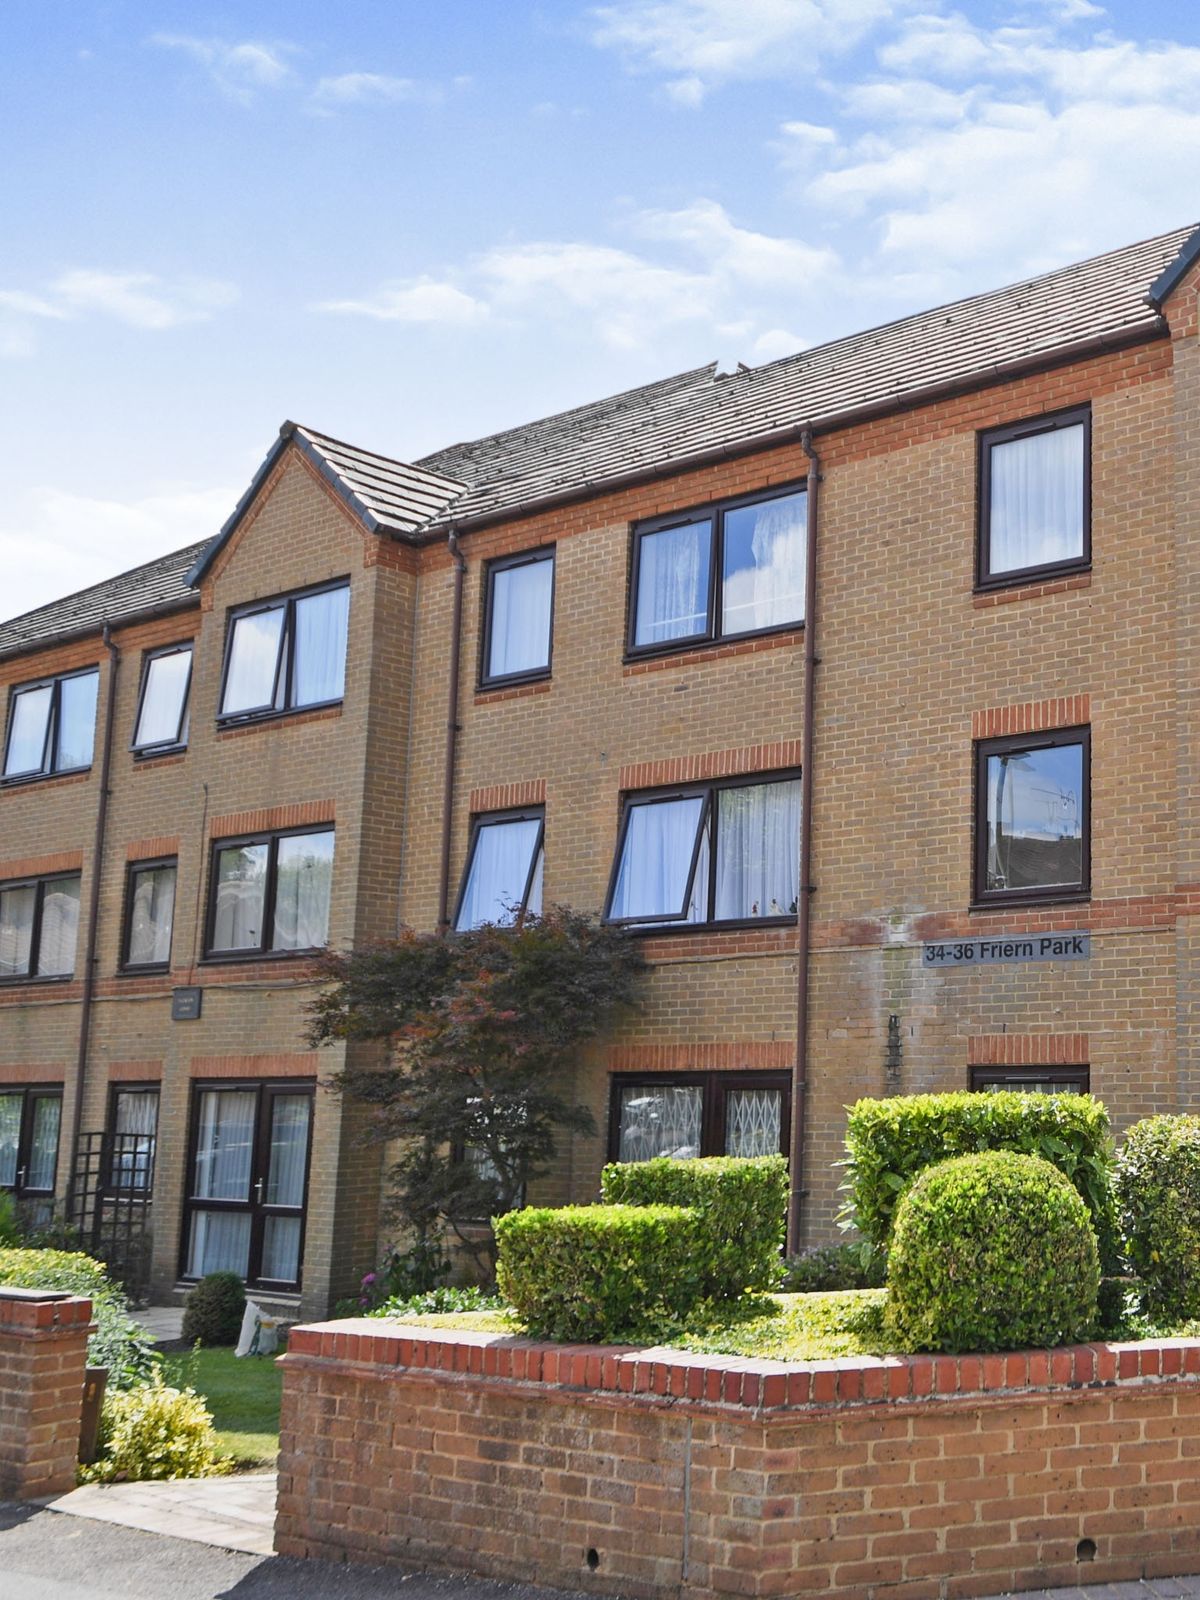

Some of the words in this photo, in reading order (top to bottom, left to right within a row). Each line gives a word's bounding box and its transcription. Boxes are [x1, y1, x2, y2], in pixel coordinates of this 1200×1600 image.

[926, 944, 974, 961] 34-36
[980, 942, 1033, 958] Friern
[1040, 937, 1083, 955] Park
